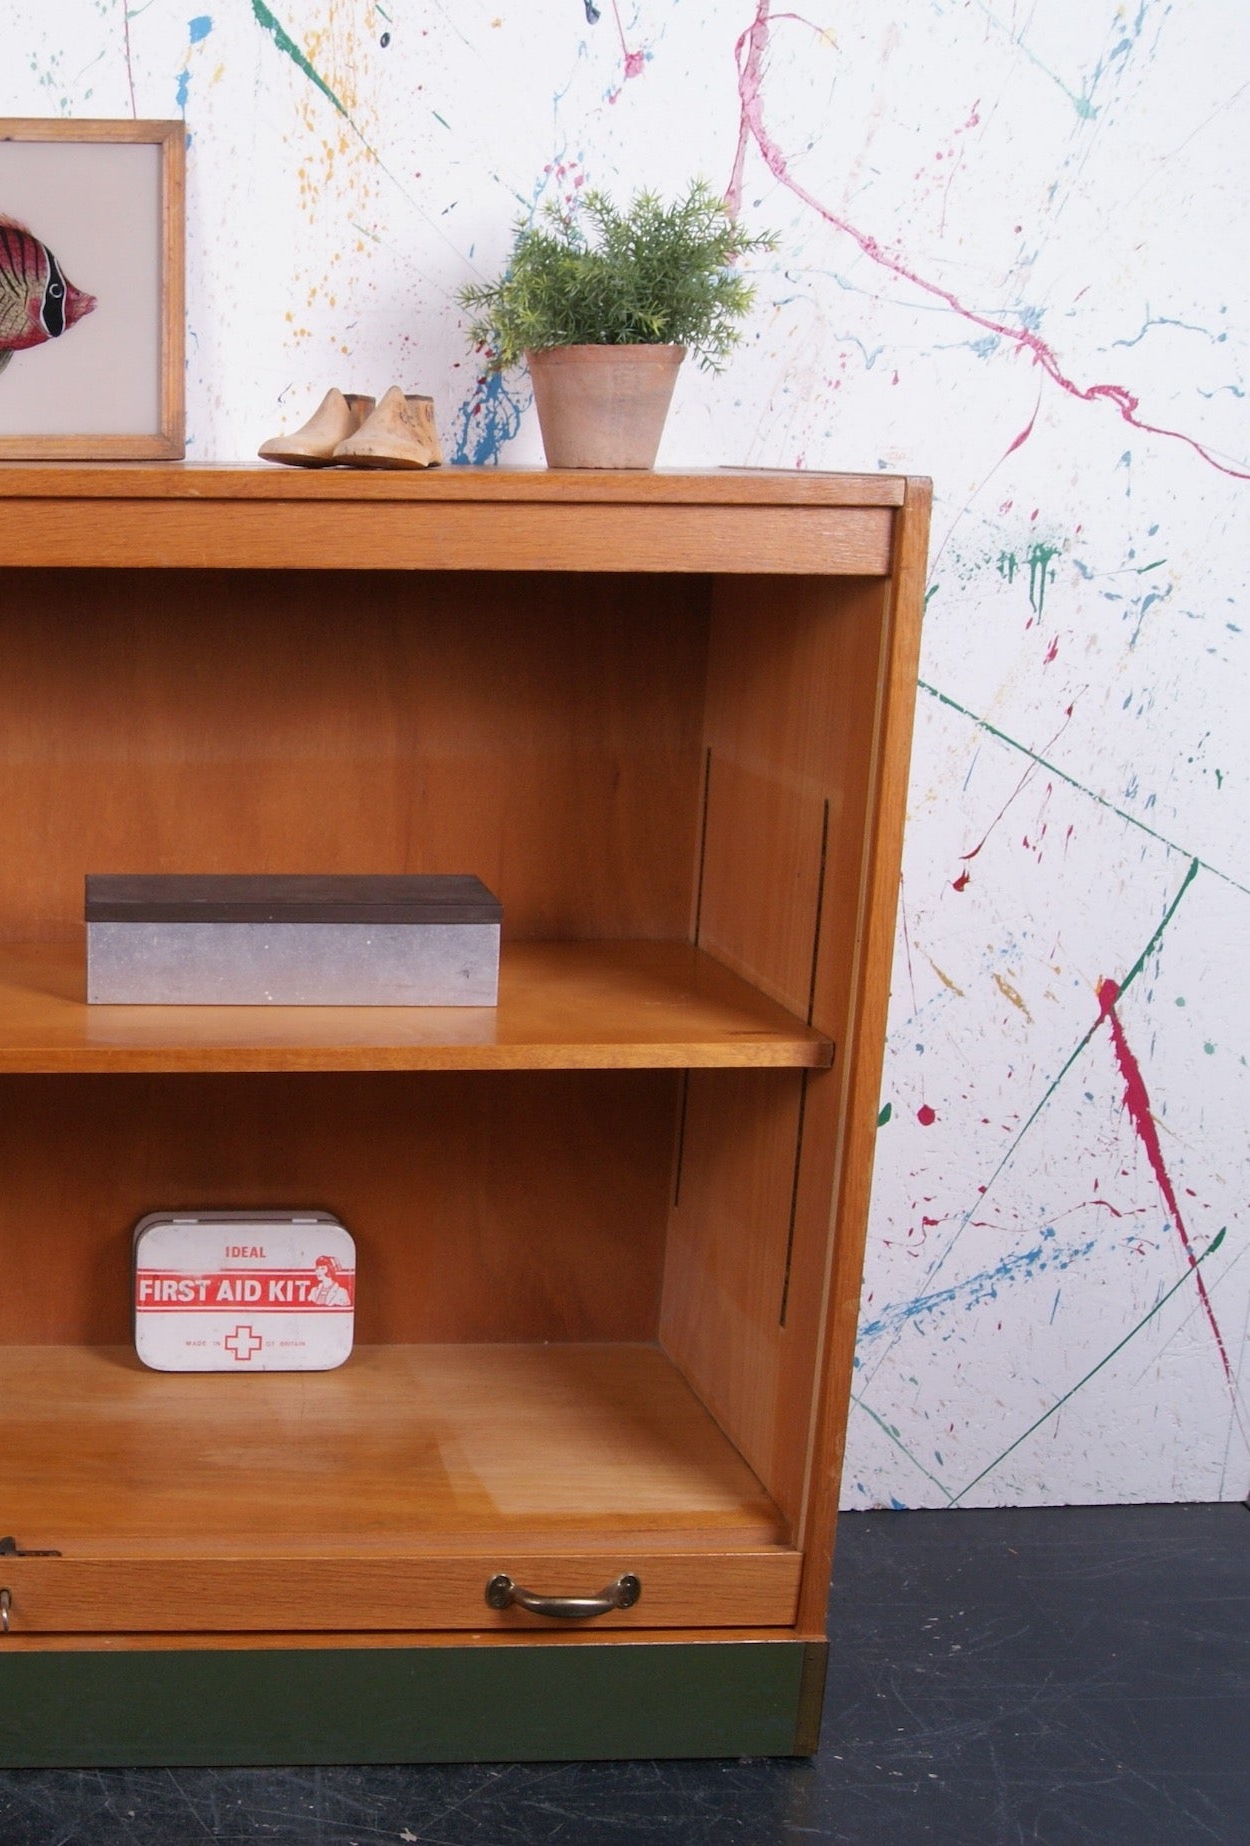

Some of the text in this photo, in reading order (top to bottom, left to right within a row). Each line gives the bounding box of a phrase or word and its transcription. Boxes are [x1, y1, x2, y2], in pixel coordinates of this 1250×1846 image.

[225, 1247, 266, 1258] IDEAL
[139, 1279, 311, 1302] FIRST AID KIT
